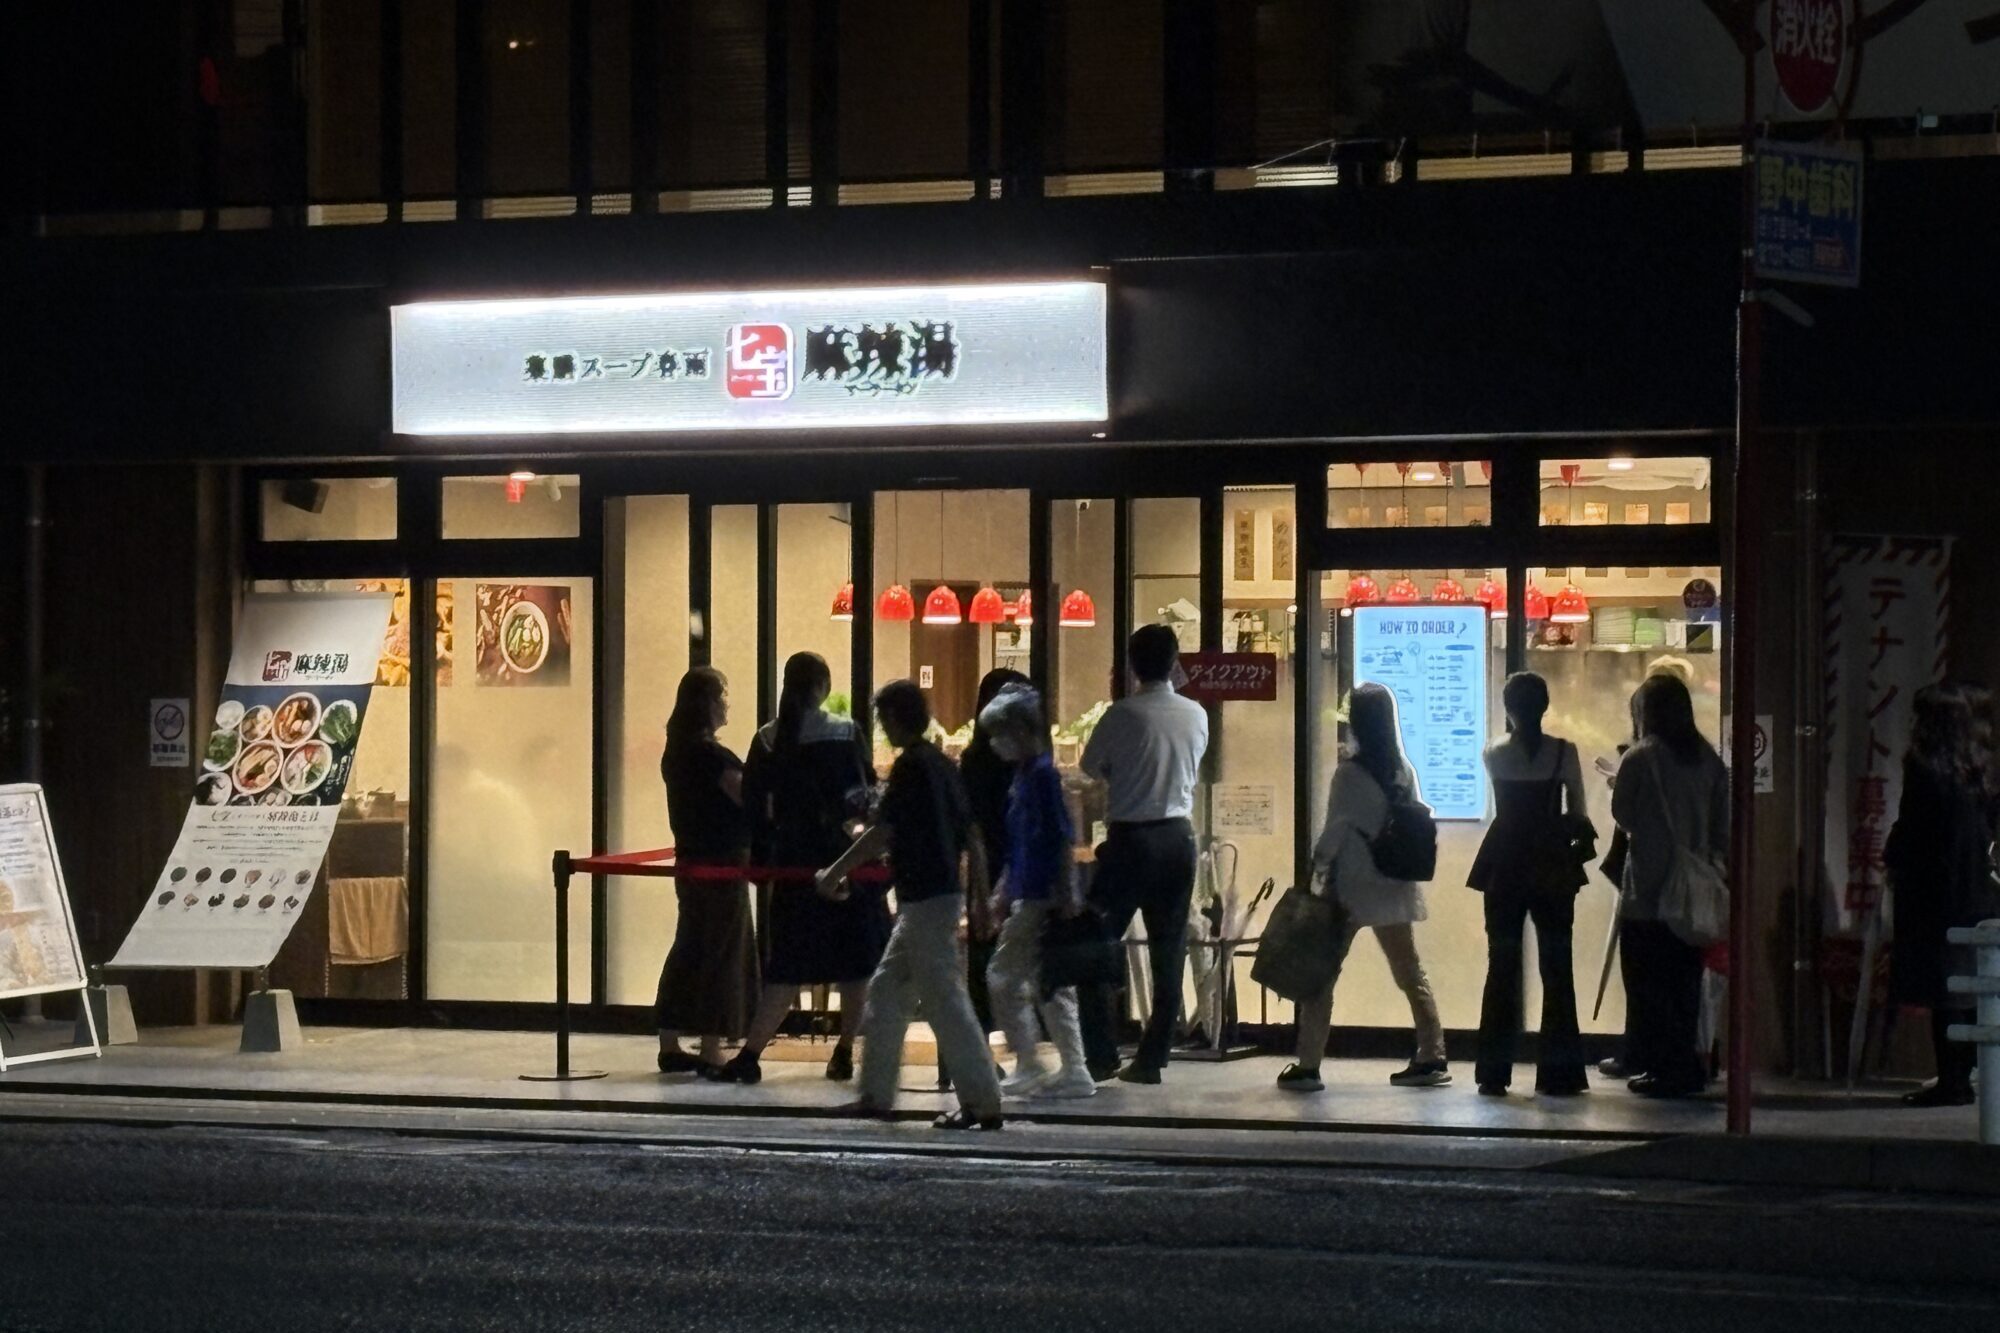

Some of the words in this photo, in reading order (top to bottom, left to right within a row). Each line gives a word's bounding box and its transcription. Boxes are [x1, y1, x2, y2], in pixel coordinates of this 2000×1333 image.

[1379, 620, 1403, 635] HOW
[1406, 620, 1418, 635] TO
[1190, 664, 1272, 681] テイクアウト
[1845, 576, 1907, 916] テナント募集中
